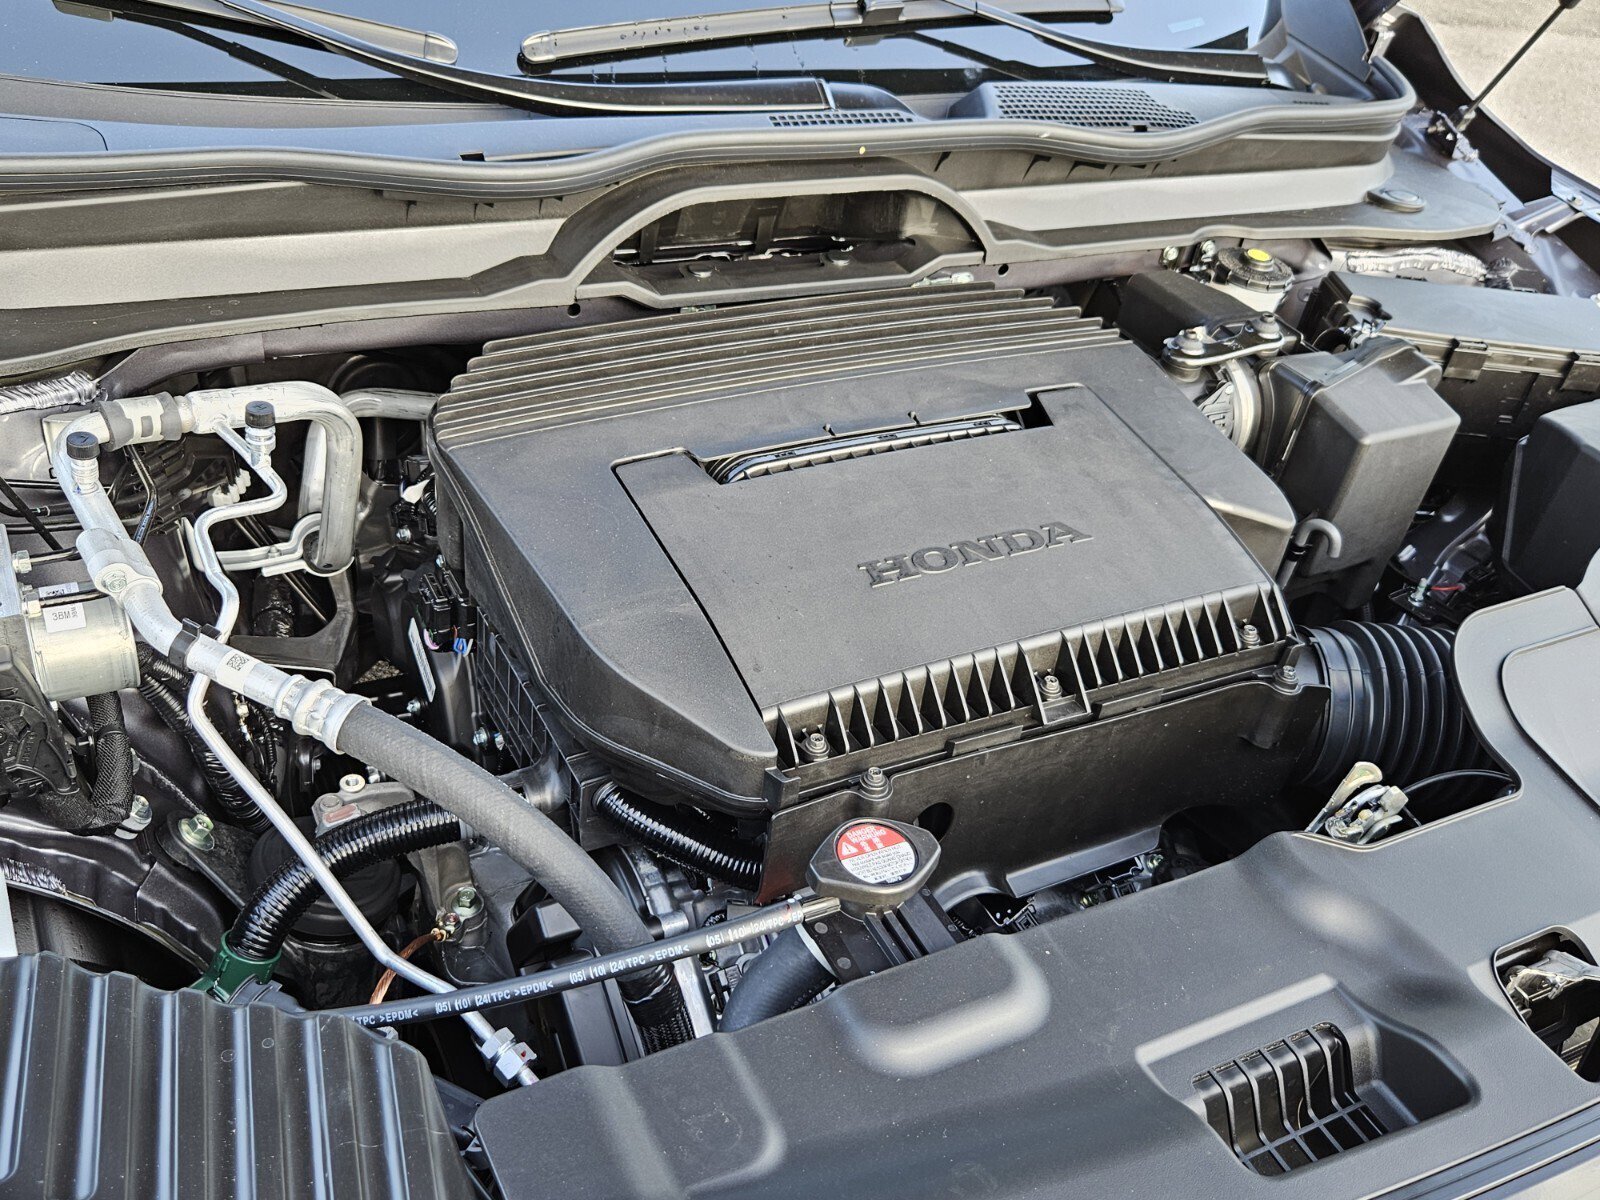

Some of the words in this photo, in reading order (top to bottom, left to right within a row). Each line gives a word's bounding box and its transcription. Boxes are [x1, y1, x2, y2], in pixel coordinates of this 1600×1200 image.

[857, 521, 1093, 588] HONDA
[846, 826, 876, 837] DANGER
[356, 1015, 375, 1025] TPC
[491, 990, 511, 1002] TPC
[626, 954, 646, 968] TPC
